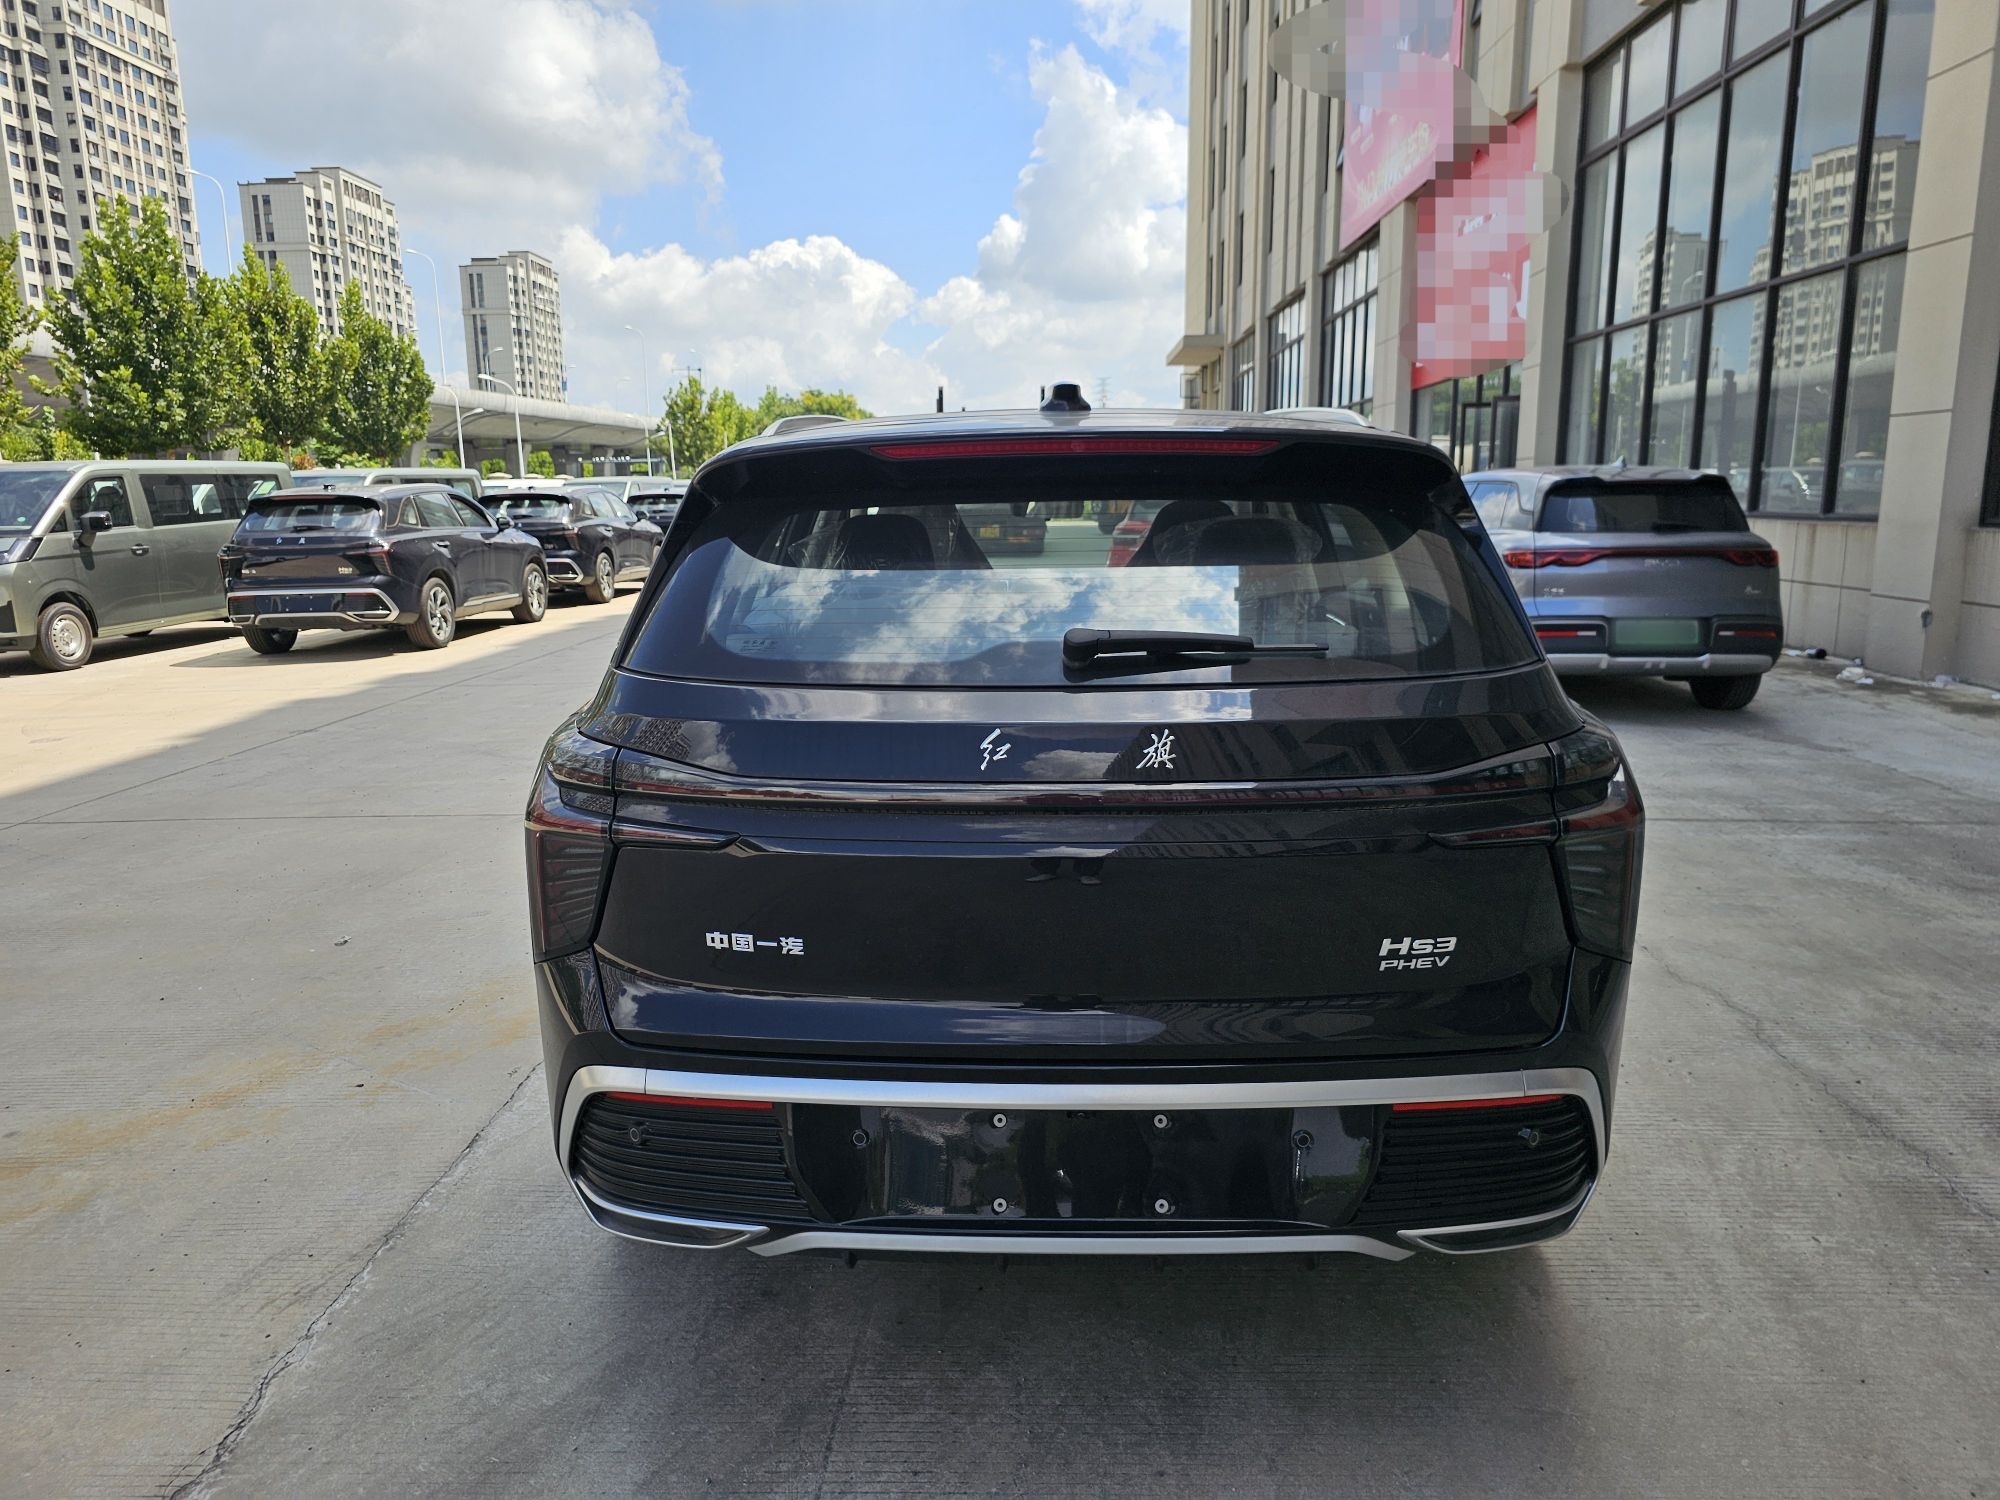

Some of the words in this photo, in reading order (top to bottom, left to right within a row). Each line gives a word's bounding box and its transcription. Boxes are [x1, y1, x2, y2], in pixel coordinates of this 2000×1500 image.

[979, 728, 1176, 771] 红旗
[705, 931, 805, 955] 中国一汽
[1378, 936, 1457, 957] HS3
[1379, 955, 1451, 972] PHEV
